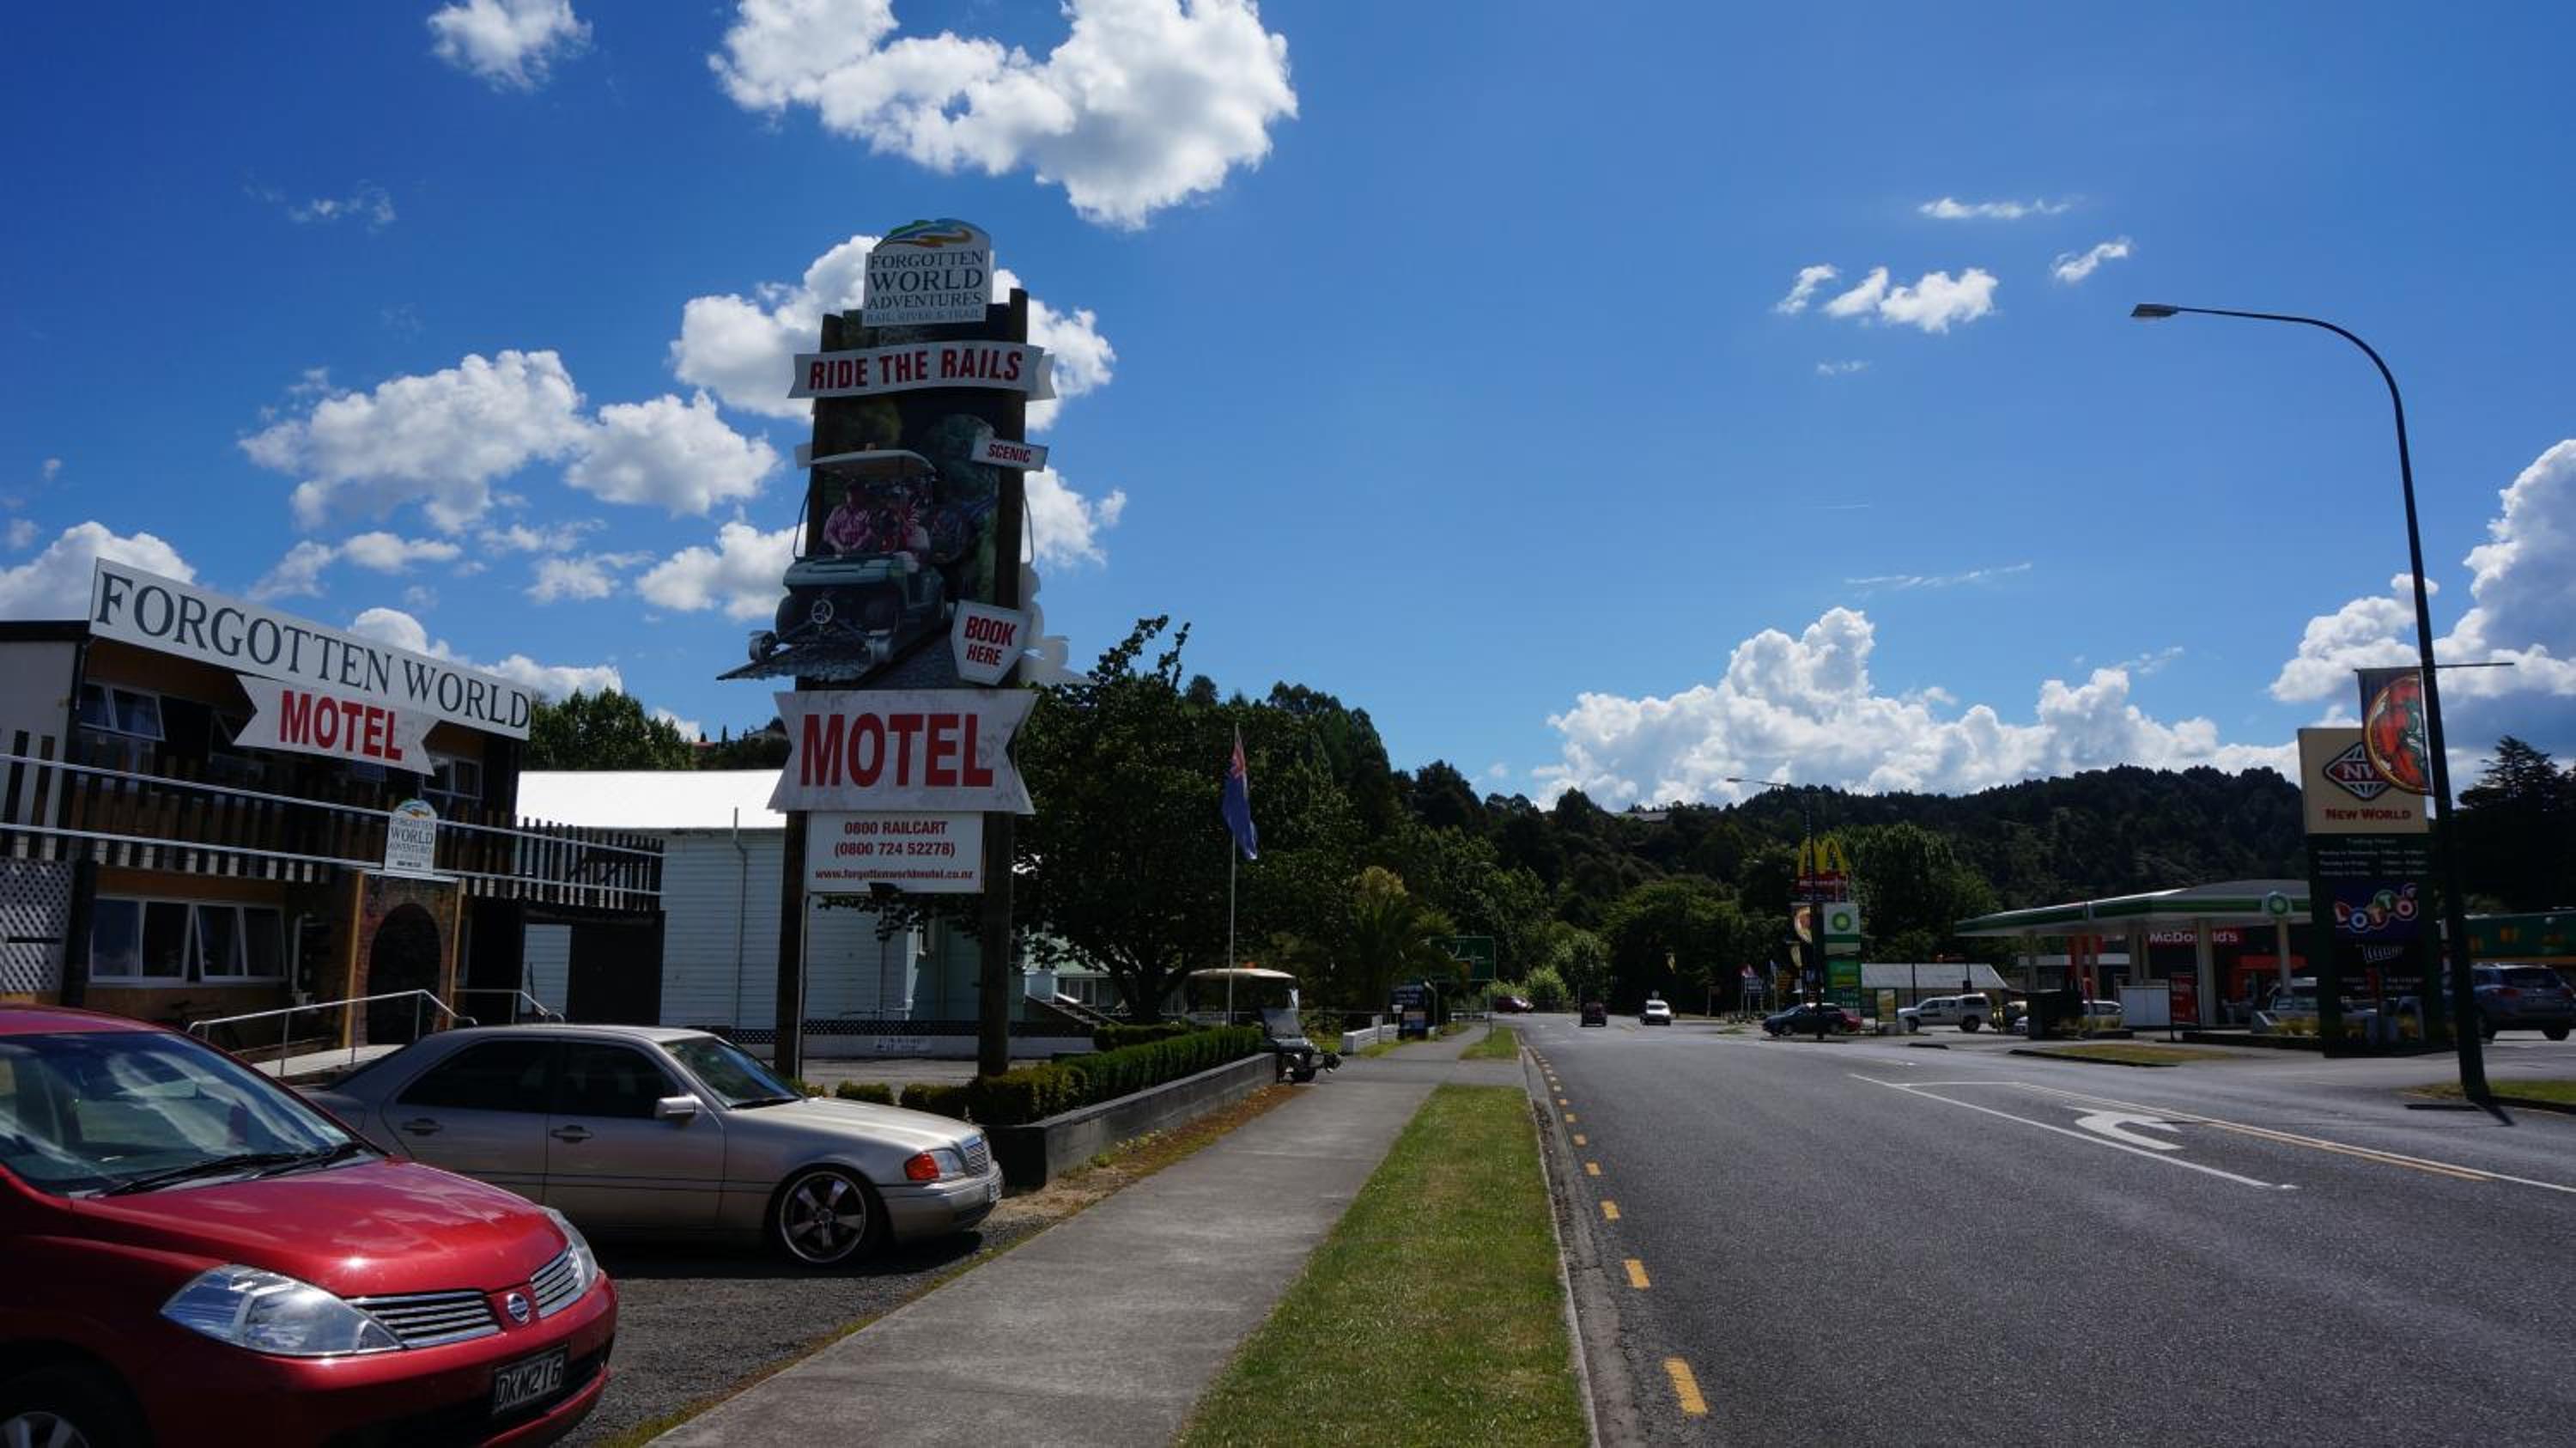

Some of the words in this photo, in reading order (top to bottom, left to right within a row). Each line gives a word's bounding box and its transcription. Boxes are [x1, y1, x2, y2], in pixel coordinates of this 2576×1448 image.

[871, 249, 984, 269] FORGOTTEN
[870, 269, 983, 292] WORLD
[867, 292, 981, 309] ADVENTURES
[808, 358, 867, 390] RIDE
[878, 350, 928, 385] THE
[940, 347, 1024, 380] RAILS
[987, 442, 1030, 464] SCENIC
[963, 615, 1018, 646] BOOK
[95, 571, 392, 695] FORGOTTEN
[404, 660, 531, 729] WORLD
[966, 646, 1004, 666] HERE
[279, 690, 403, 761] MOTEL
[800, 713, 993, 788] MOTEL
[391, 826, 434, 845] WORLD
[844, 822, 878, 835] 0800
[882, 821, 949, 835] RAILCART
[835, 842, 873, 858] (0800
[878, 843, 902, 855] 724
[907, 842, 956, 858] 52278)
[2149, 930, 2239, 943] McDold's
